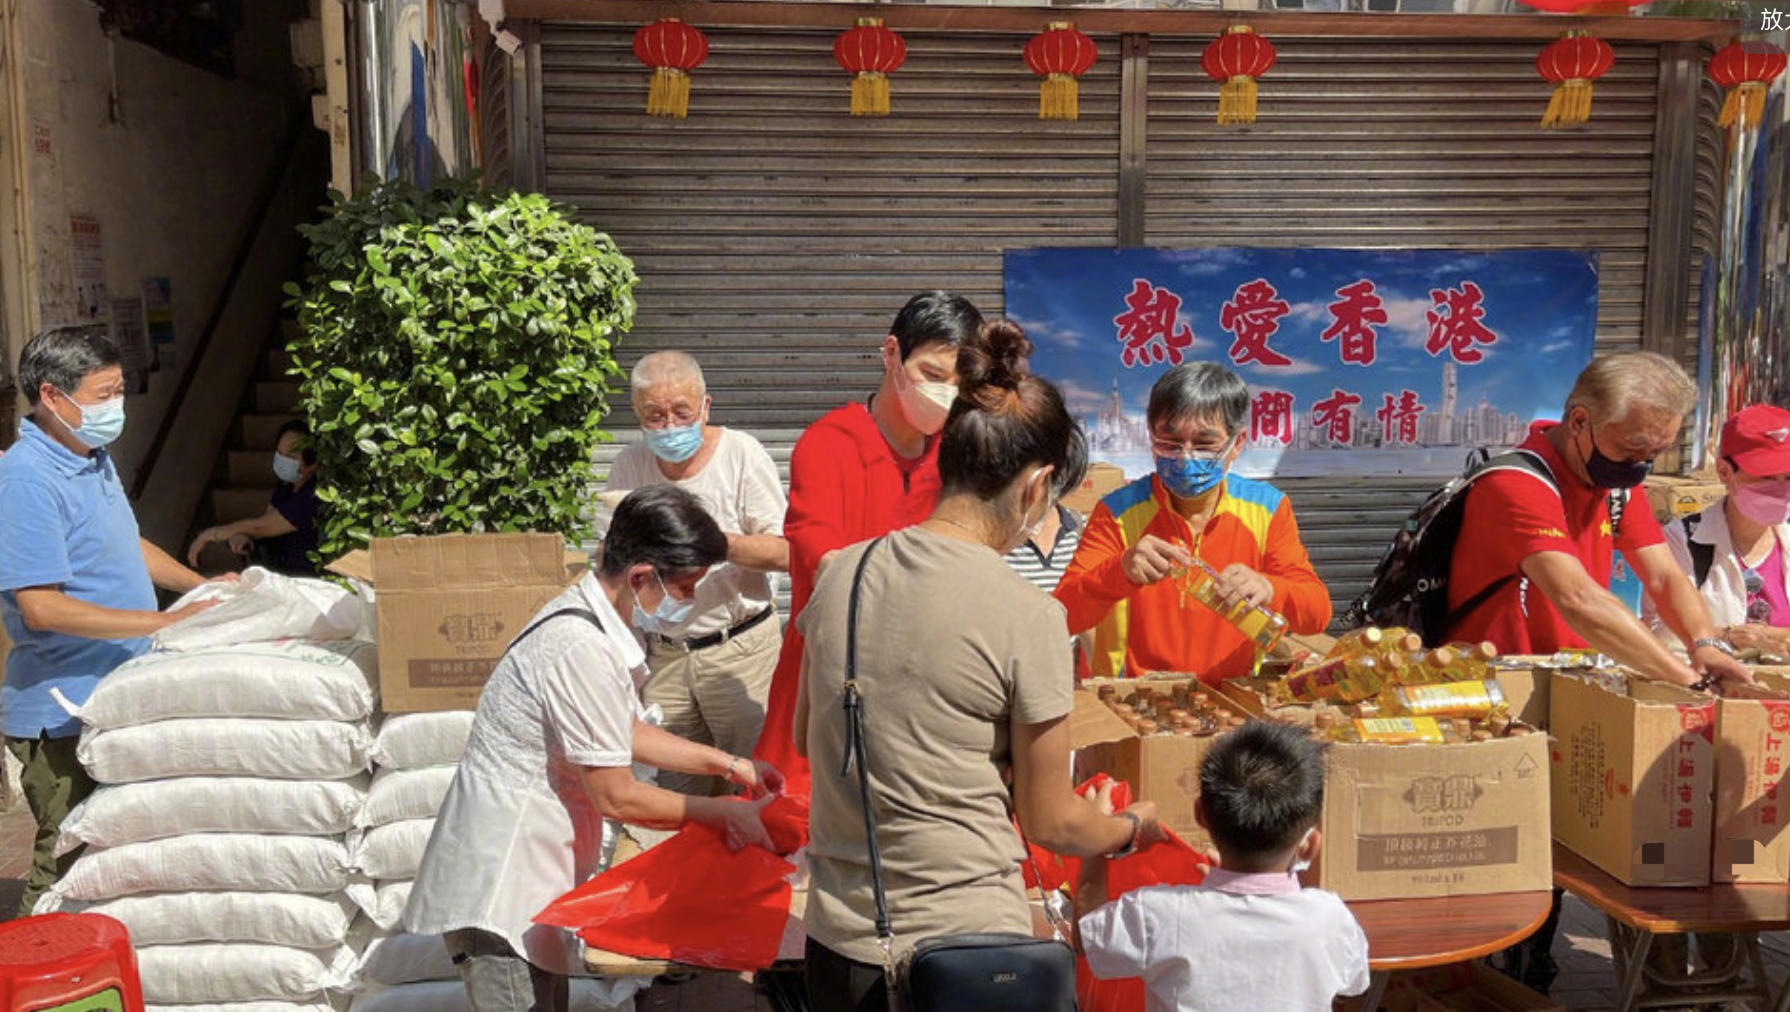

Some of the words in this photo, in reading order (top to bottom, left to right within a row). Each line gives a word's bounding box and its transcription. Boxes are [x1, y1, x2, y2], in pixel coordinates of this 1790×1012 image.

[1113, 278, 1498, 367] 熱愛香港
[1251, 391, 1426, 446] 間有情
